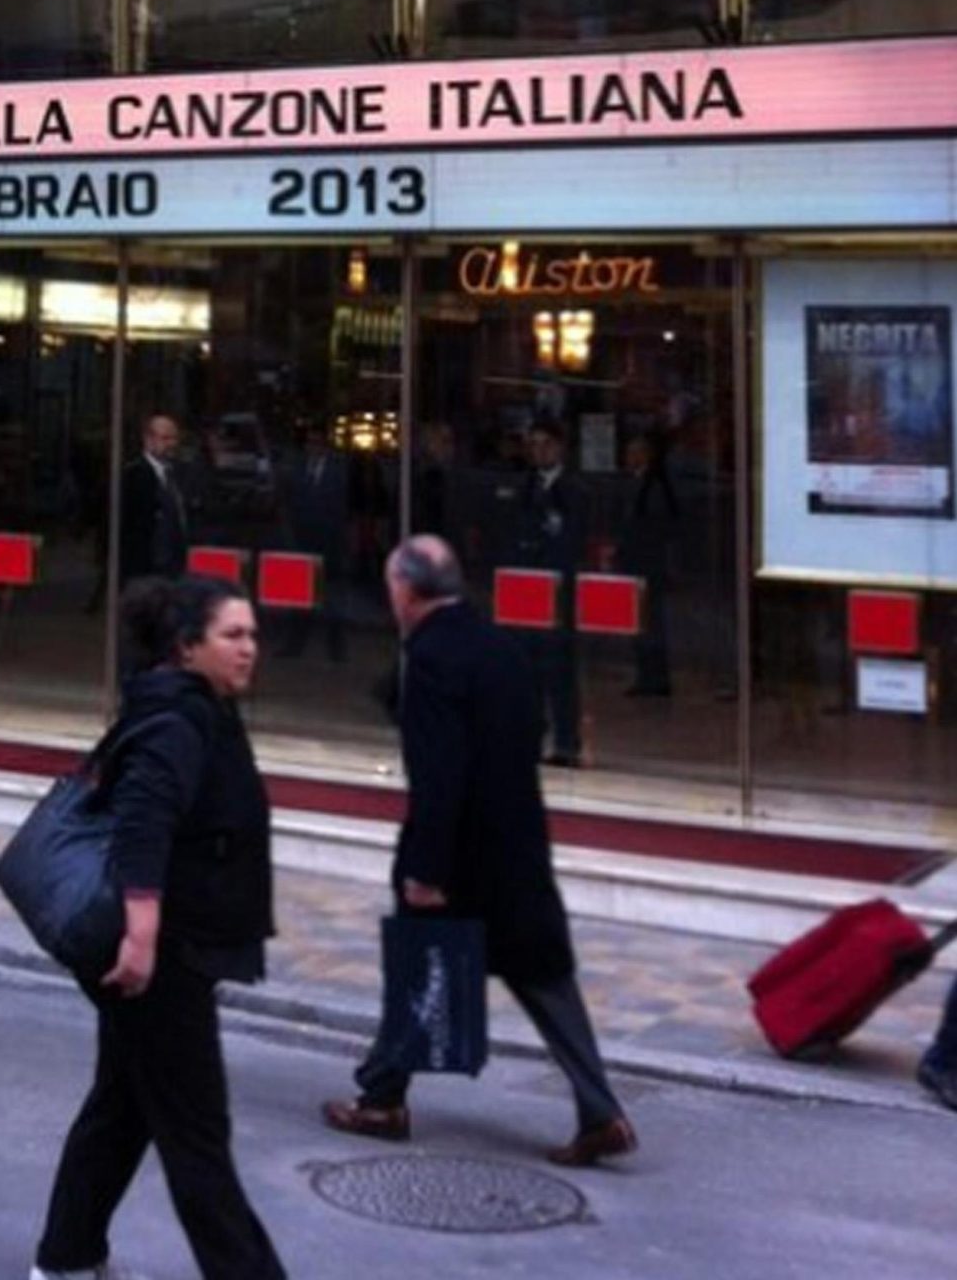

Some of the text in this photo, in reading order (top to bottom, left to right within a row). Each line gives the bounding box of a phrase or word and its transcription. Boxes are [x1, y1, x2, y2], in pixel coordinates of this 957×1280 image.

[106, 83, 387, 140] CANZONE
[429, 67, 745, 131] ITALIANA
[267, 166, 427, 216] 2013
